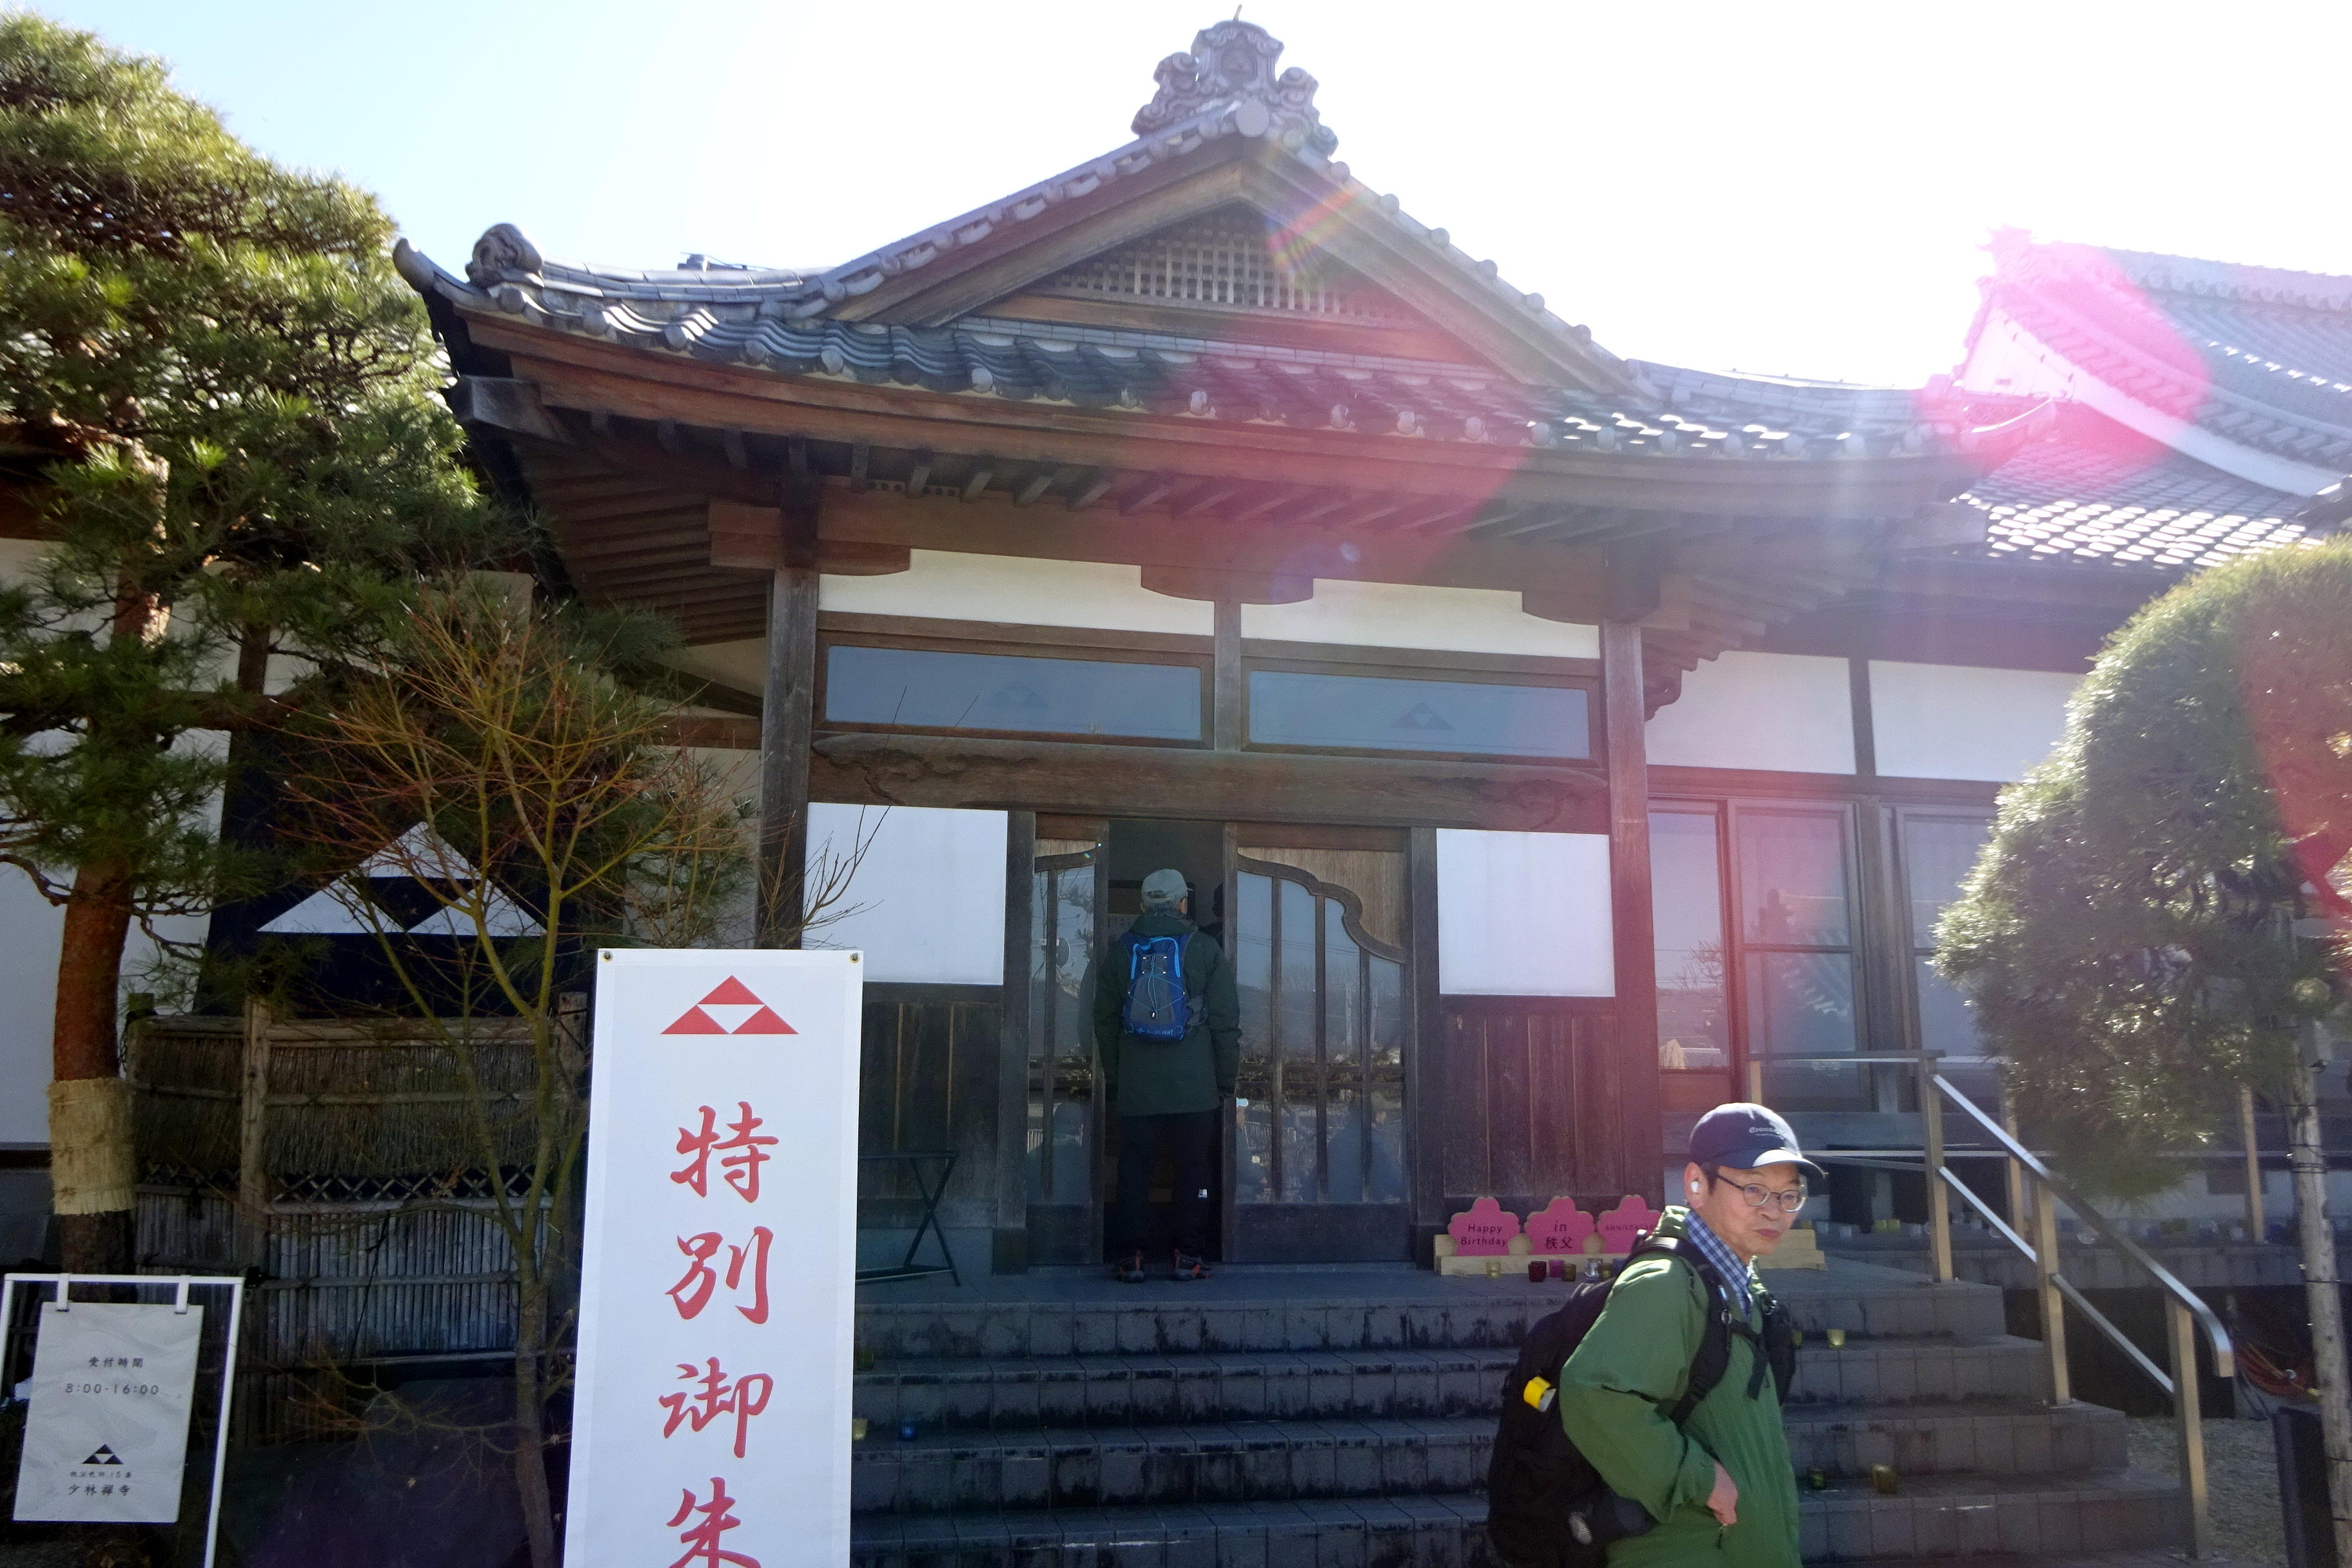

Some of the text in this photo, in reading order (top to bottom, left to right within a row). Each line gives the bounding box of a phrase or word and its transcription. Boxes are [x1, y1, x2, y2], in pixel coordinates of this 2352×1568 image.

[1467, 1224, 1503, 1233] Happy
[1554, 1220, 1567, 1232] in
[1460, 1236, 1507, 1246] Birthday
[1545, 1236, 1573, 1250] 秩父
[659, 1101, 779, 1568] 特別御朱
[88, 1356, 144, 1368] 受付時間
[65, 1383, 159, 1395] 8:00-16:00
